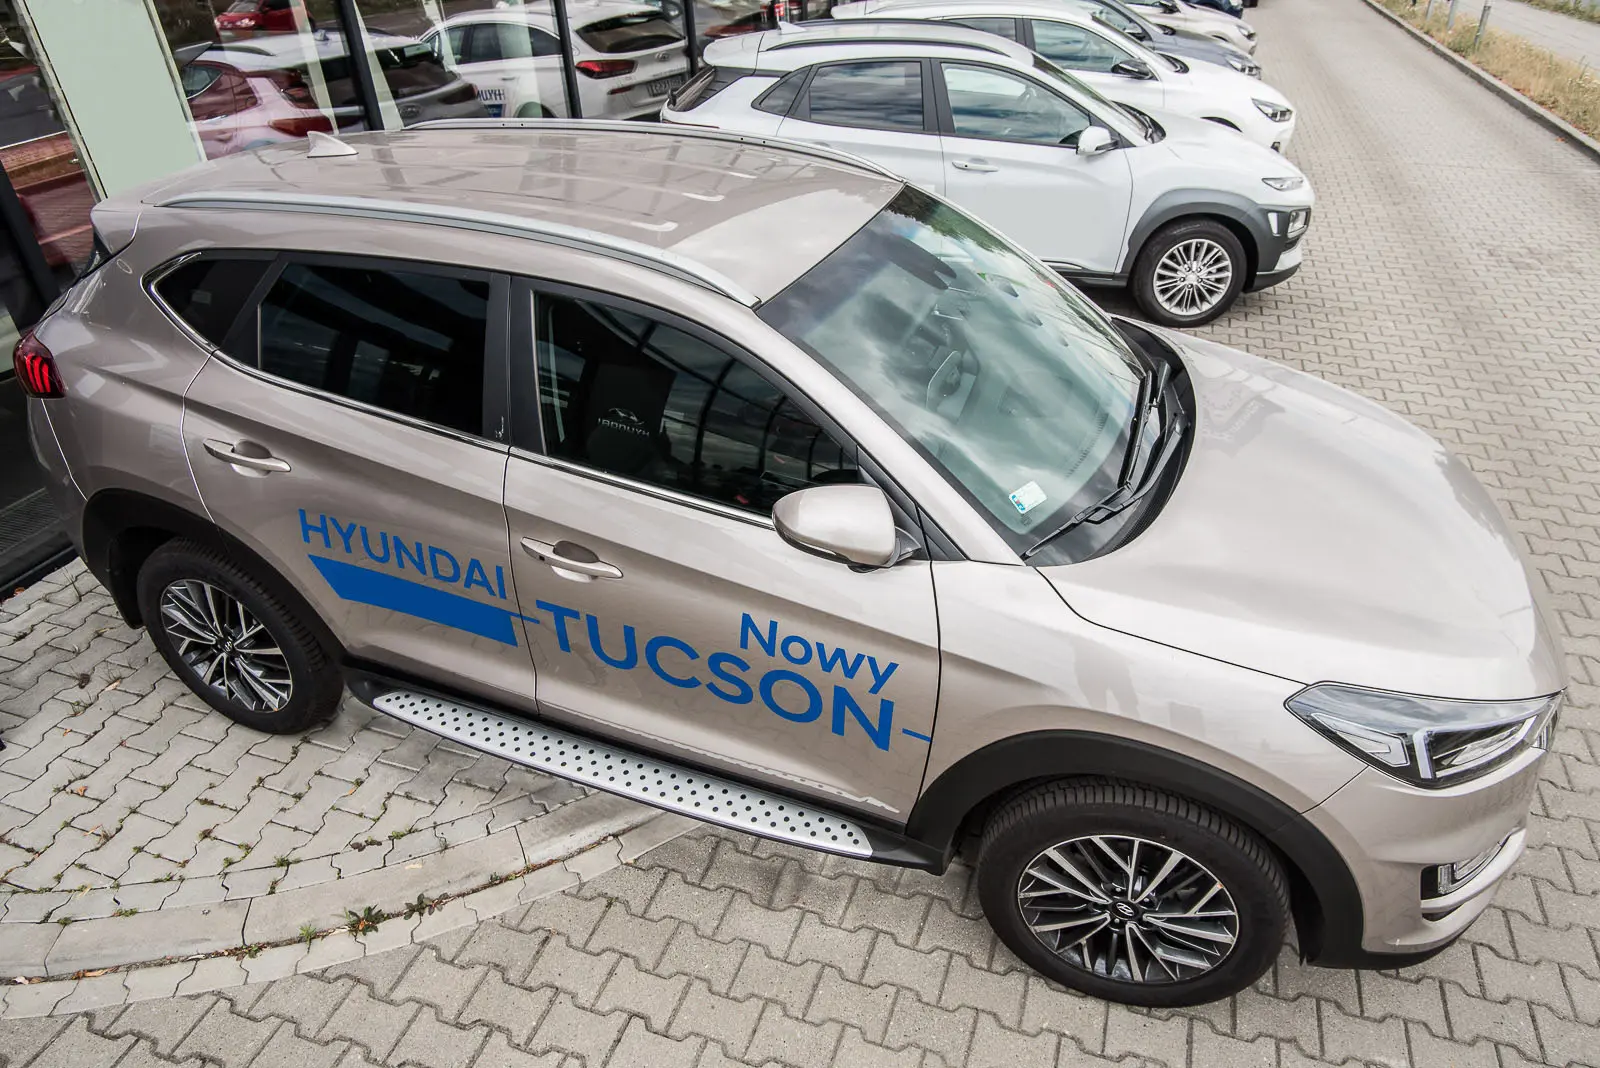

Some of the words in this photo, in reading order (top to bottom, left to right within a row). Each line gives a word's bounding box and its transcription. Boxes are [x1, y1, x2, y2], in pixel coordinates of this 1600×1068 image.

[298, 509, 507, 599] HYUNDAI
[536, 600, 895, 751] TUCSON
[740, 613, 898, 694] Nowy
